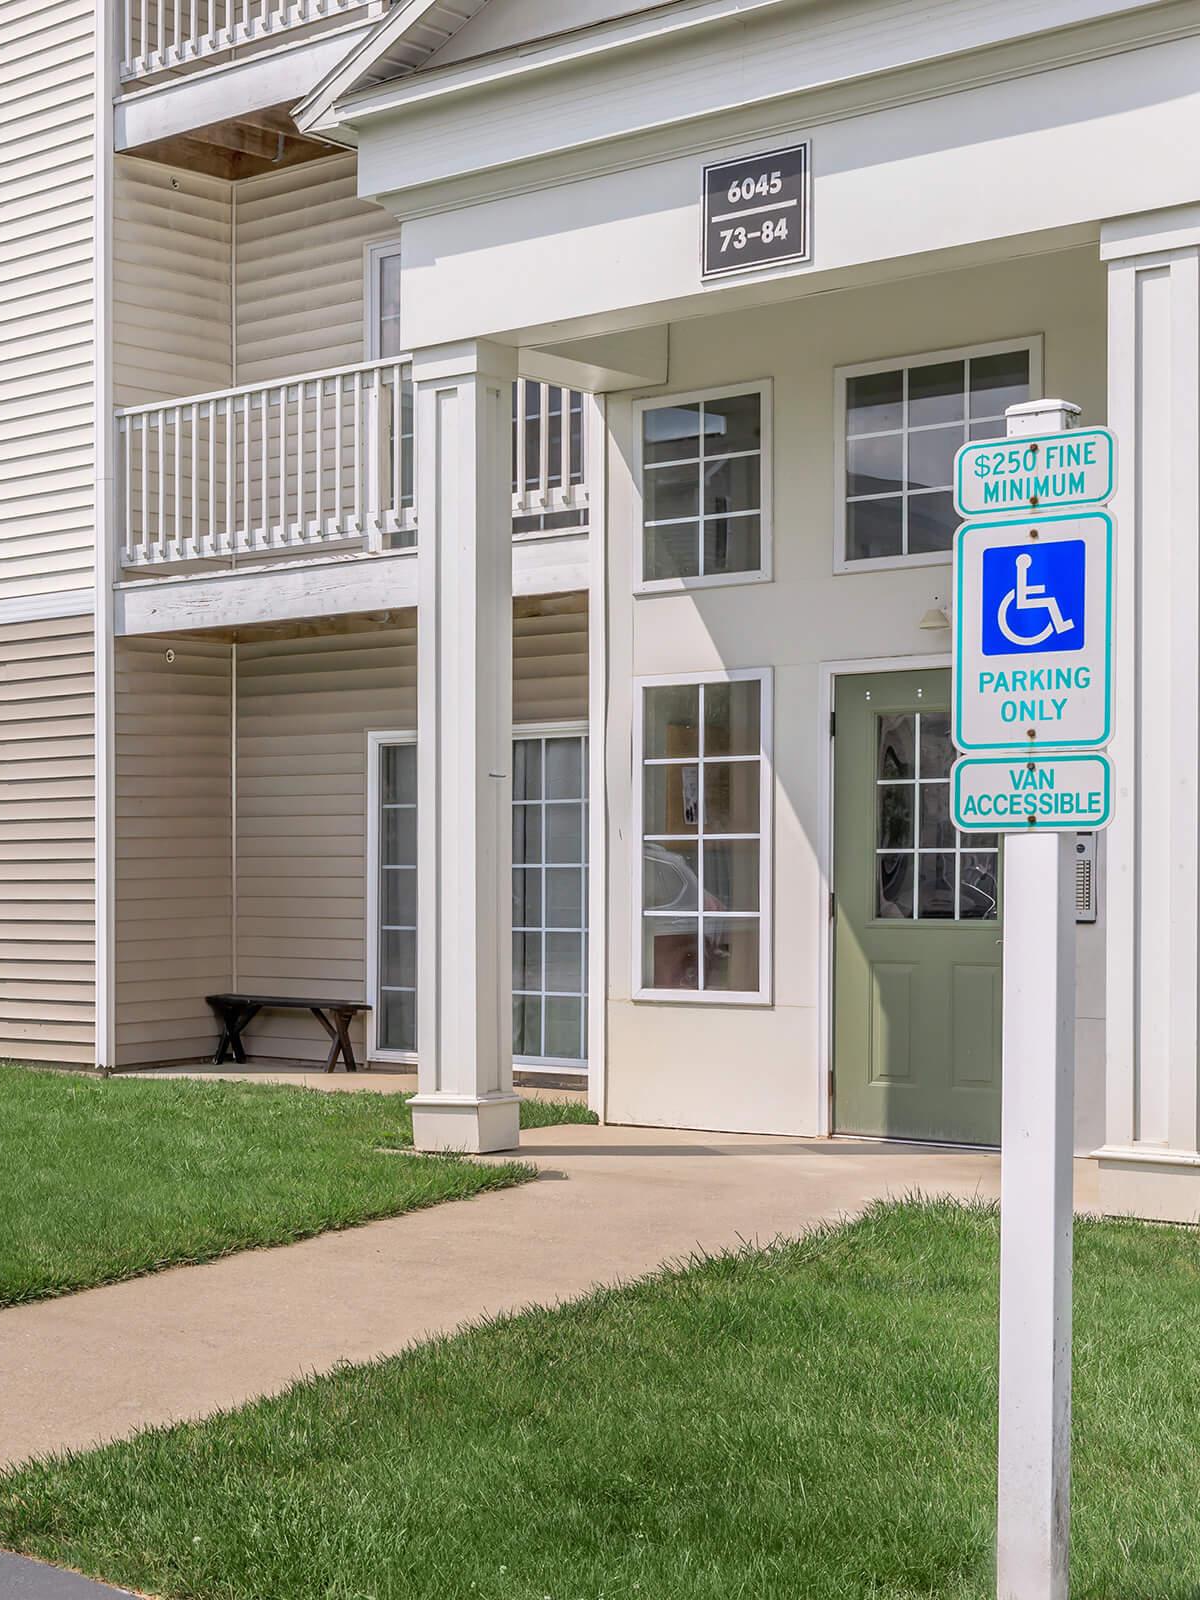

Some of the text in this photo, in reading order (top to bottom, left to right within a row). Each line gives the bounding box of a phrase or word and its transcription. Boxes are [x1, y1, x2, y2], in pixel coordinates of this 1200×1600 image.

[727, 171, 782, 203] 6045
[719, 217, 788, 252] 73-84
[974, 441, 1097, 479] $250 FINE
[984, 471, 1086, 504] MINIMUM
[979, 666, 1091, 693] PARKING
[1001, 698, 1068, 723] ONLY
[1009, 768, 1055, 791] VAN
[963, 792, 1102, 816] ACCESSIBLE
